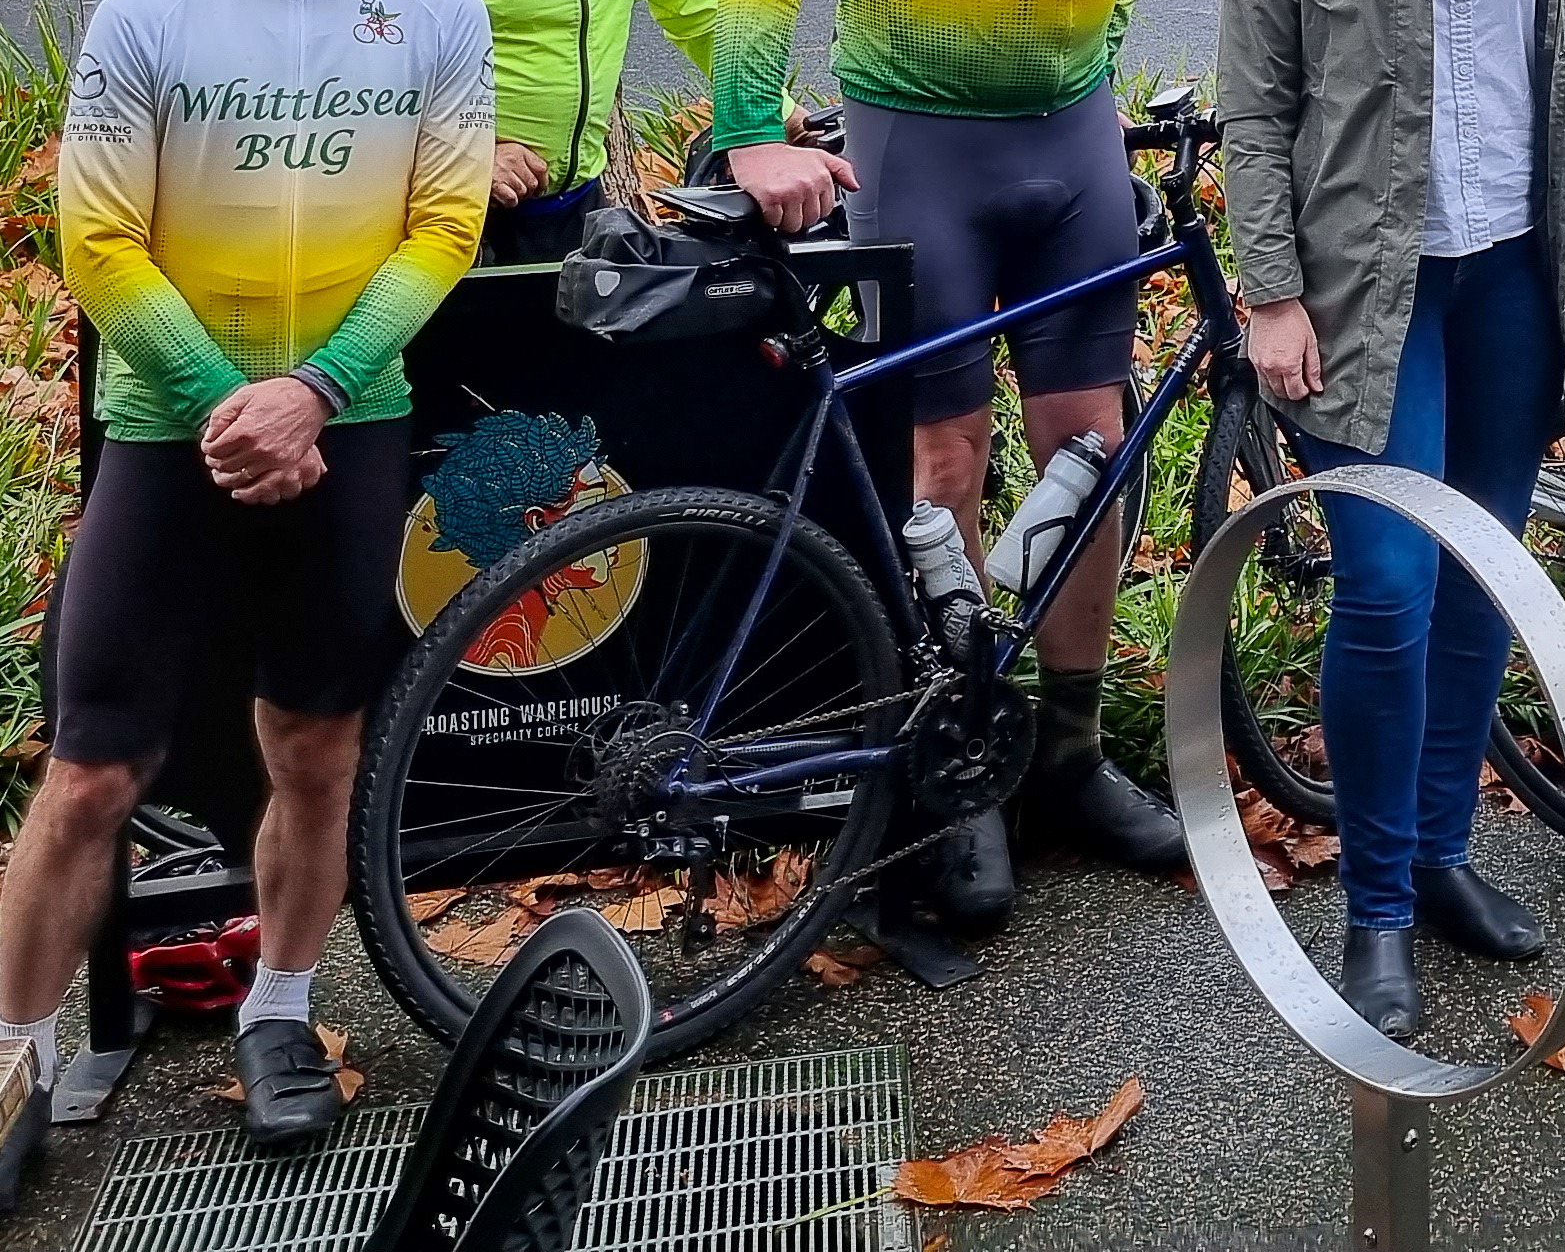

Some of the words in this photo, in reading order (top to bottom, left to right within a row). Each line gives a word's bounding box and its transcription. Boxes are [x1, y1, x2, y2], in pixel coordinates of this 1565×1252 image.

[170, 77, 422, 123] Whittlesea
[234, 129, 356, 176] BUG
[682, 508, 767, 526] PIRELLI
[426, 706, 510, 736] ROASTING
[519, 693, 621, 724] WAREHOUSE
[470, 727, 532, 746] SPECIALTY
[537, 722, 580, 738] COFFEE
